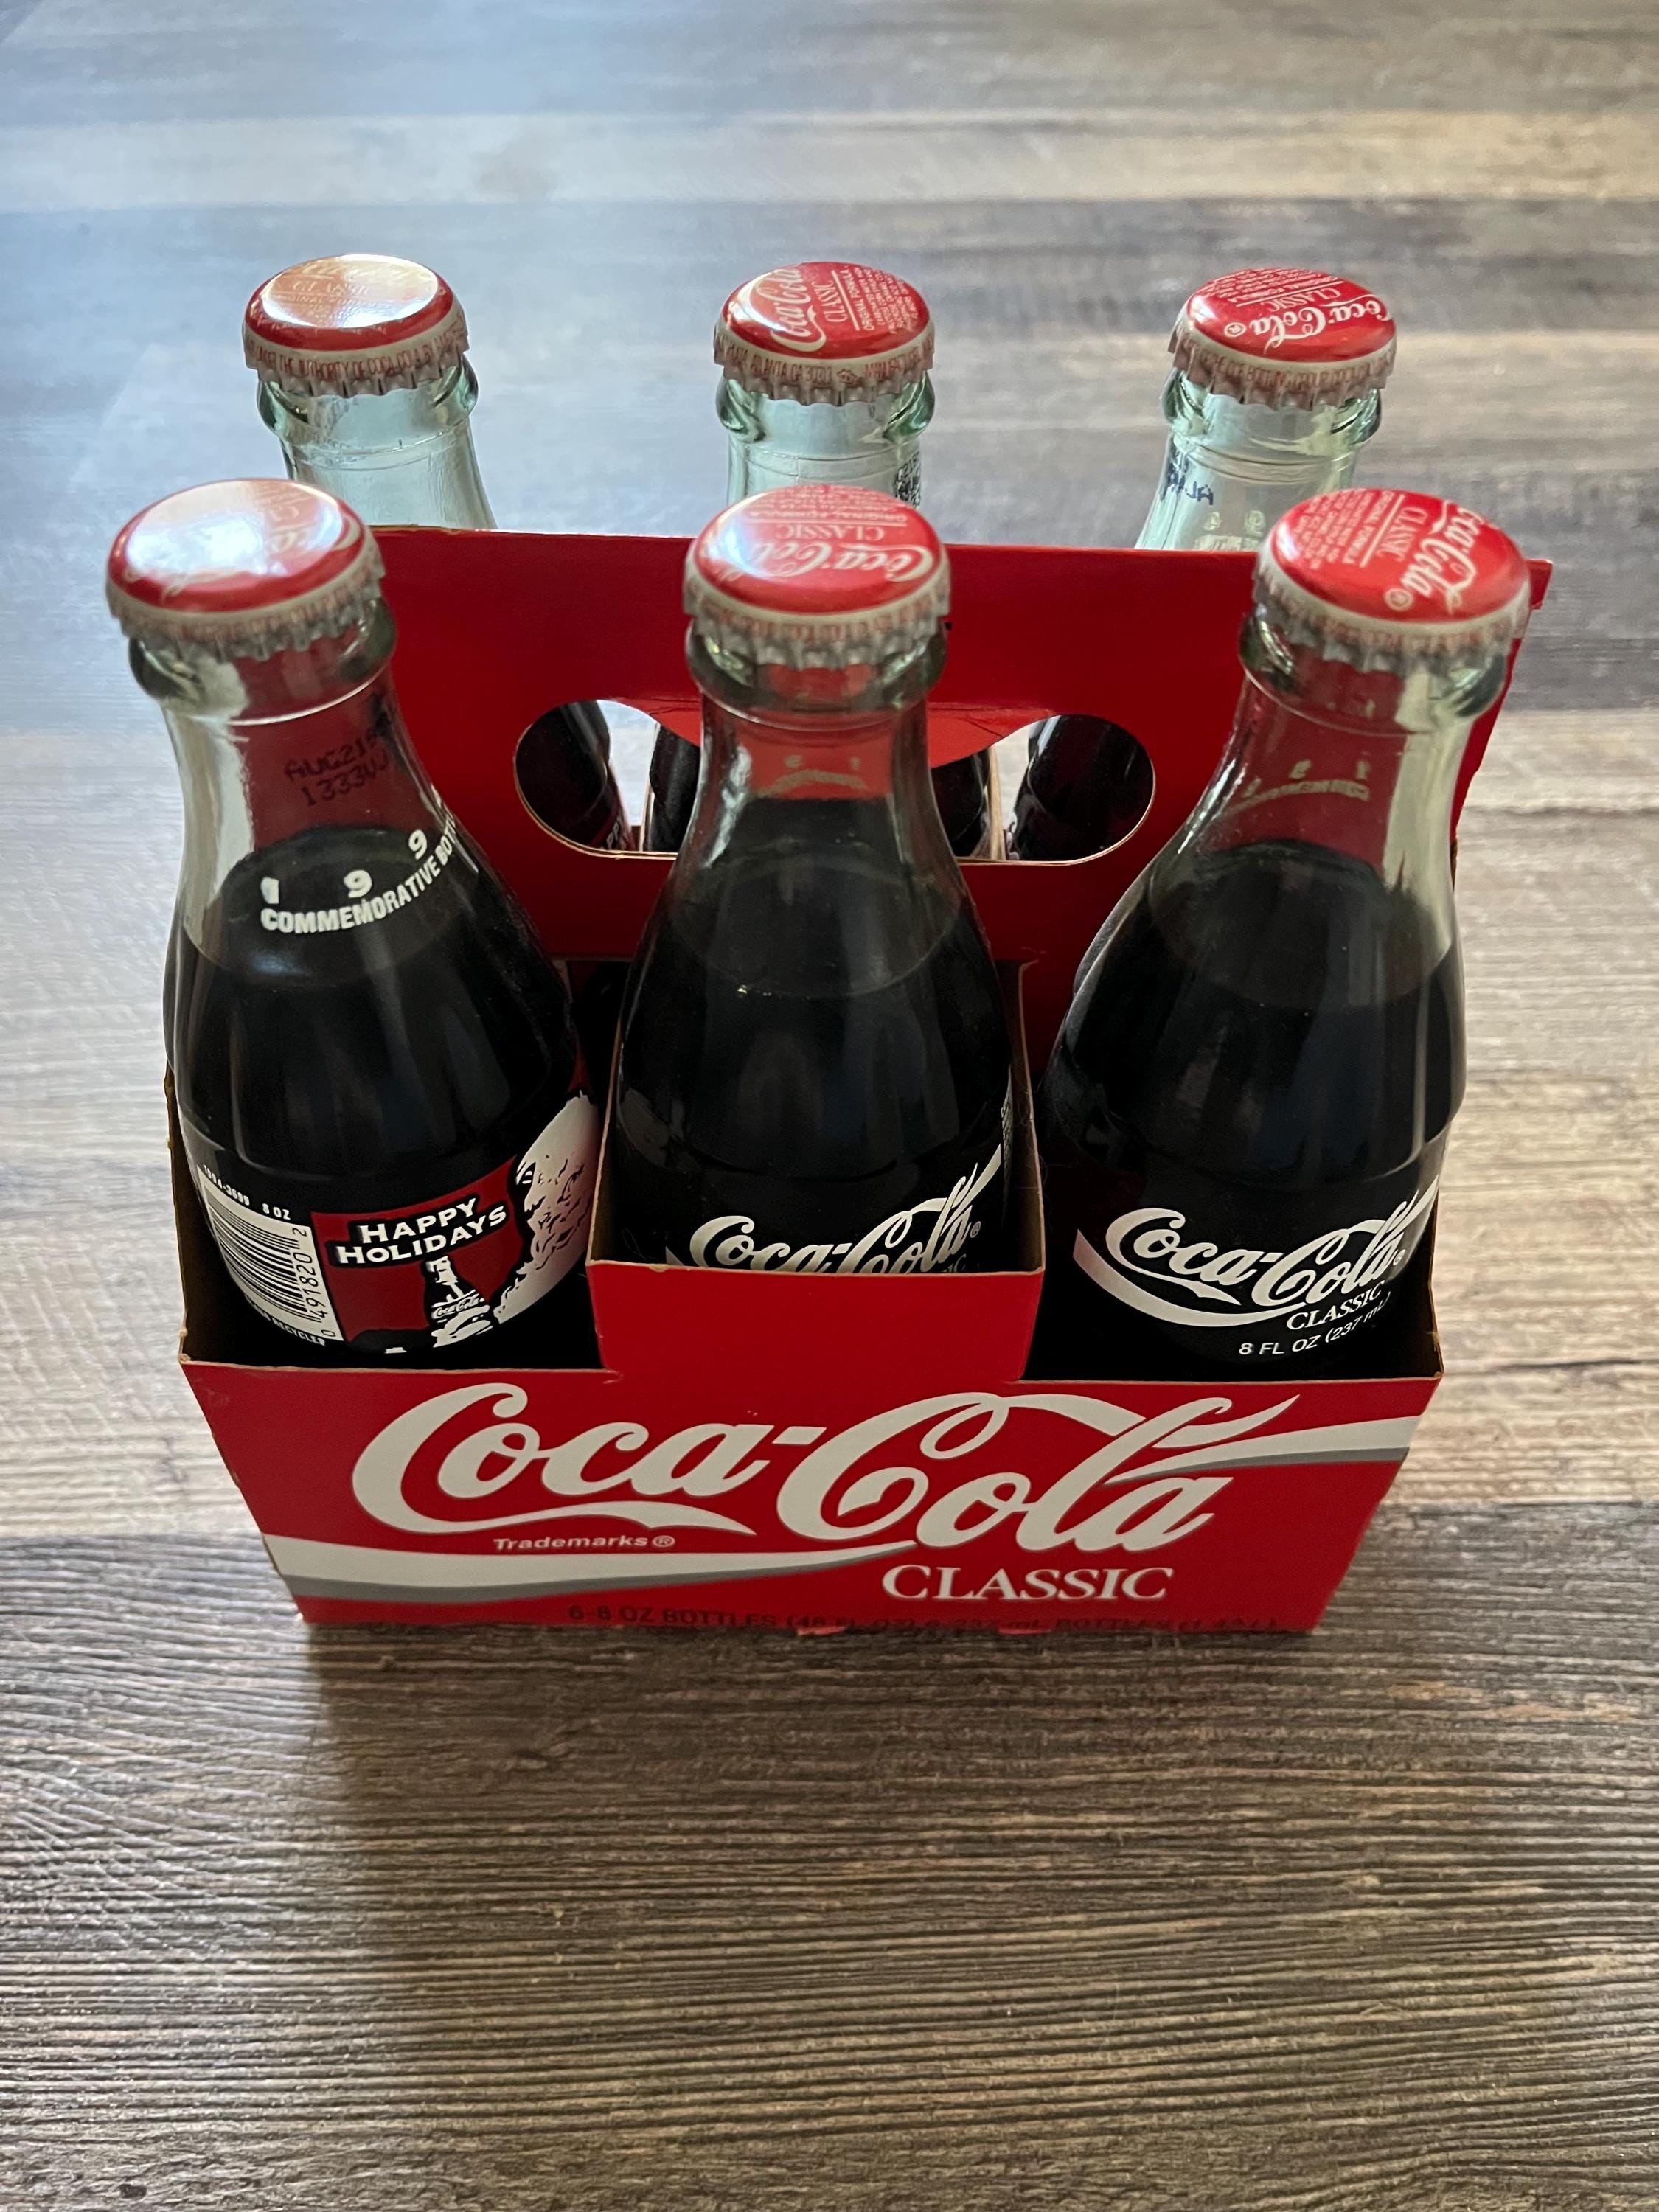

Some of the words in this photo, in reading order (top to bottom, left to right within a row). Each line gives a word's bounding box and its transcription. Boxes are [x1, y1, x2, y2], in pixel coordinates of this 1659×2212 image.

[812, 280, 848, 324] CLASSIC
[1260, 288, 1341, 312] CLASSIC
[776, 523, 886, 542] CLASSIC
[343, 869, 372, 898] 9
[408, 829, 428, 860] 9
[260, 855, 442, 934] COMMEMORATIVE
[336, 1206, 507, 1265] HOLIDAYS
[358, 1197, 476, 1244] HAPPY
[1105, 1189, 1419, 1307] Coca-Cola
[1286, 1279, 1385, 1330] CLASSIC
[1238, 1342, 1254, 1356] 8
[1258, 1342, 1285, 1355] FL
[1291, 1335, 1321, 1352] OZ
[1324, 1315, 1363, 1343] (237
[351, 1382, 1301, 1553] Coca-Cola
[881, 1563, 1174, 1601] CLASSIC
